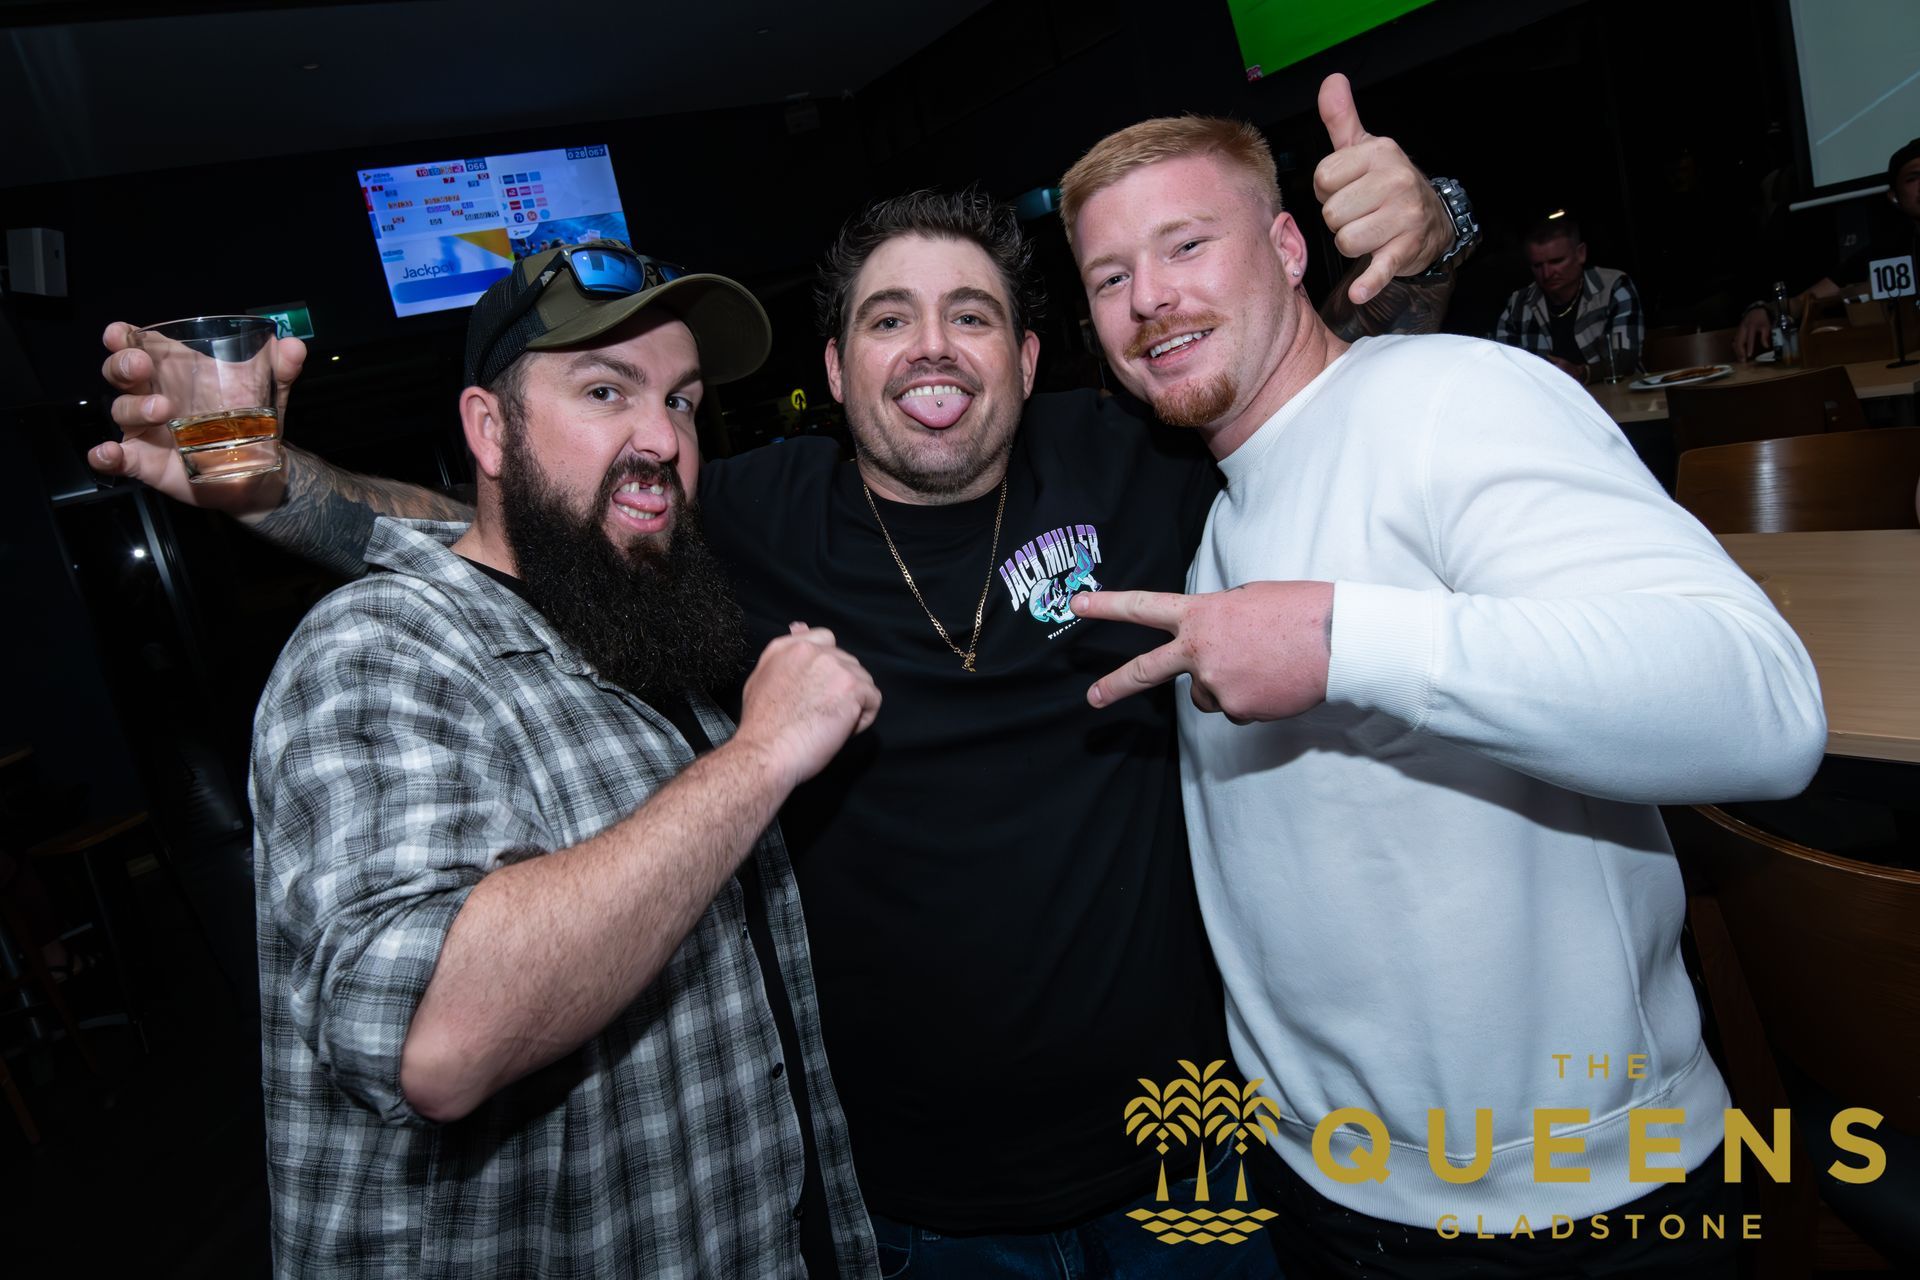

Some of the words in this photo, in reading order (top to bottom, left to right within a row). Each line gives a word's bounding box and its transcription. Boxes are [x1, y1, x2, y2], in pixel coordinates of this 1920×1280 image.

[588, 147, 604, 157] 067
[467, 161, 486, 171] 066
[403, 262, 456, 279] Jackpot
[1874, 263, 1911, 292] 108
[998, 541, 1047, 612] JACK
[1036, 524, 1102, 578] MILLER
